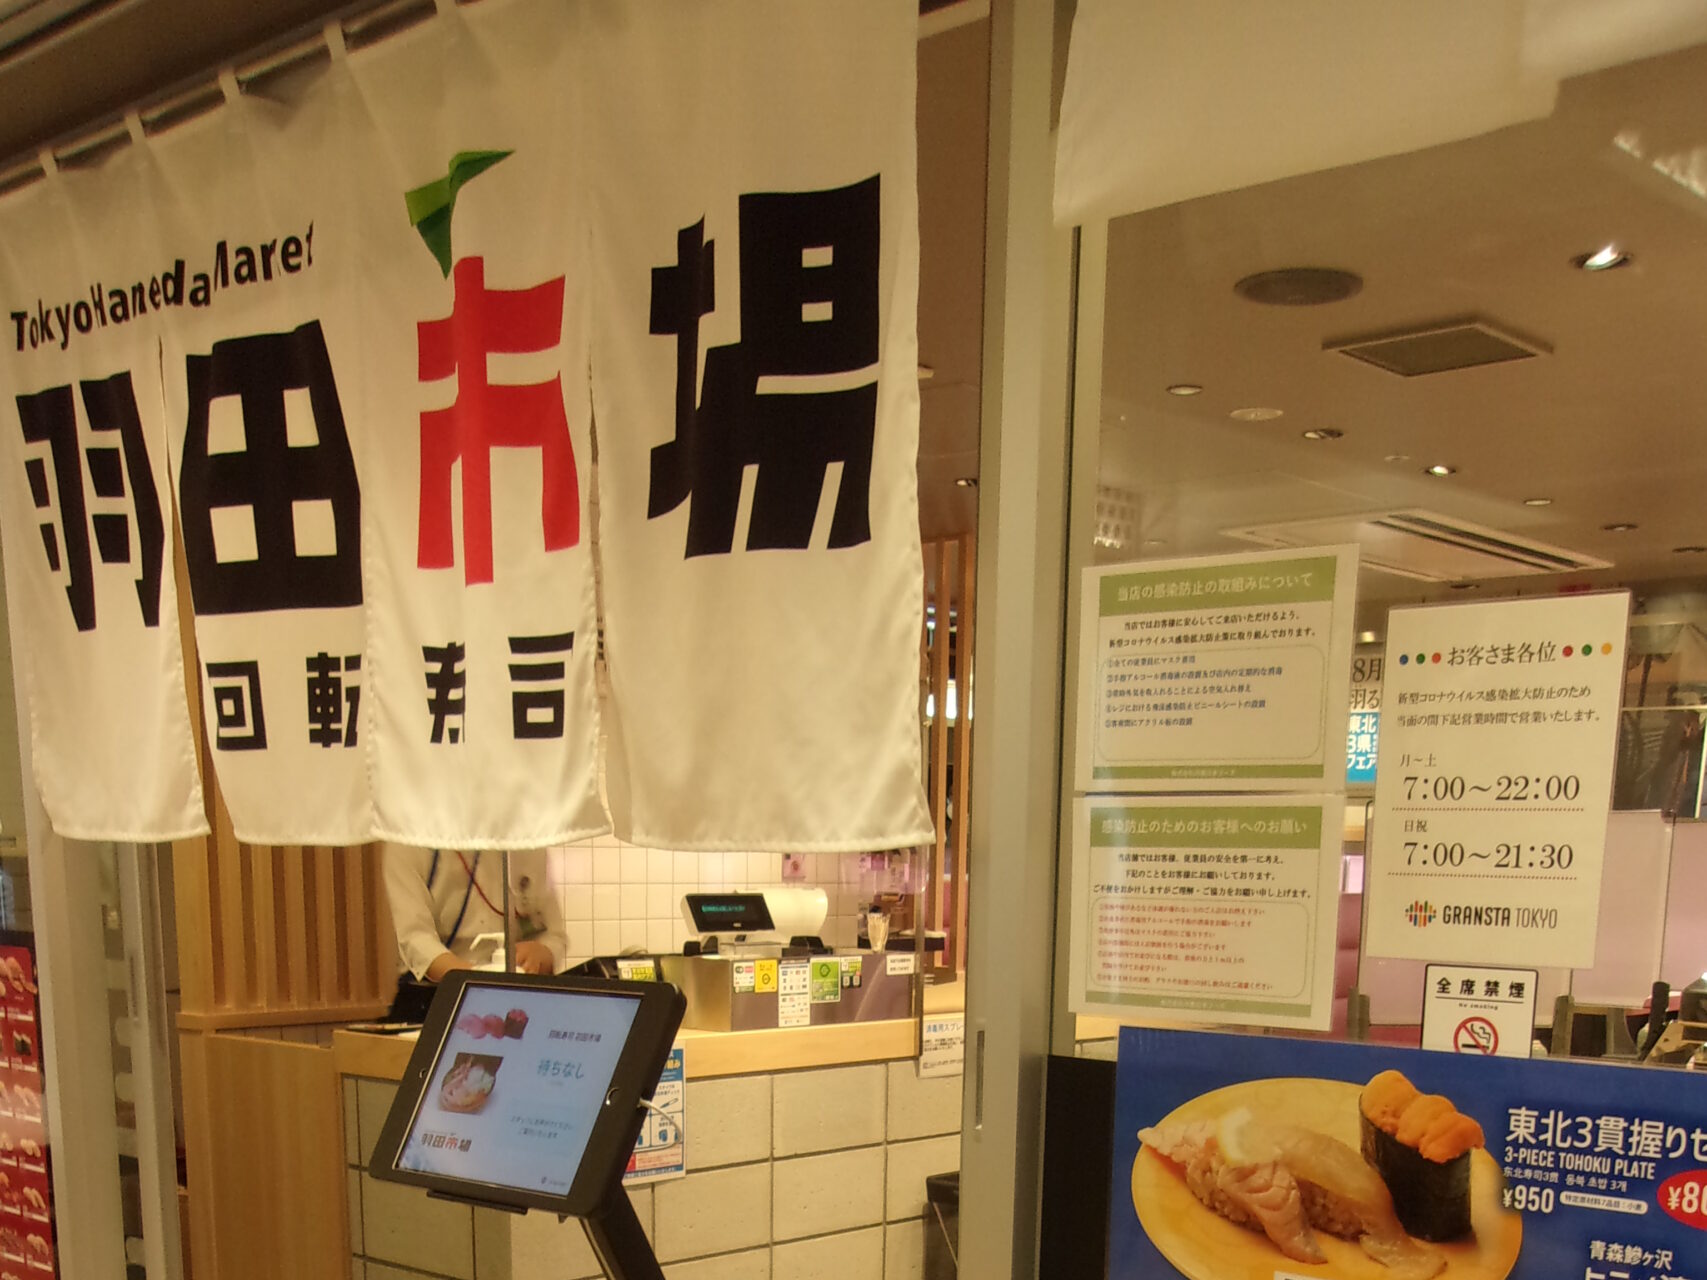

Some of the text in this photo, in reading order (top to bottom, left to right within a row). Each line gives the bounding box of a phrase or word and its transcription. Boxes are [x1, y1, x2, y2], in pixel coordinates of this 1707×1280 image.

[1446, 640, 1557, 667] お客さま各位
[1398, 685, 1592, 705] 新型コロナウイルス感染拡大防止のため
[1403, 819, 1428, 833] 日祝
[1442, 904, 1558, 929] GRANSTA TOKYO
[1435, 976, 1525, 999] 全席禁煙
[1504, 1146, 1656, 1180] 3-PIECE TOHOKU PLATE
[1502, 1184, 1555, 1214] ¥950
